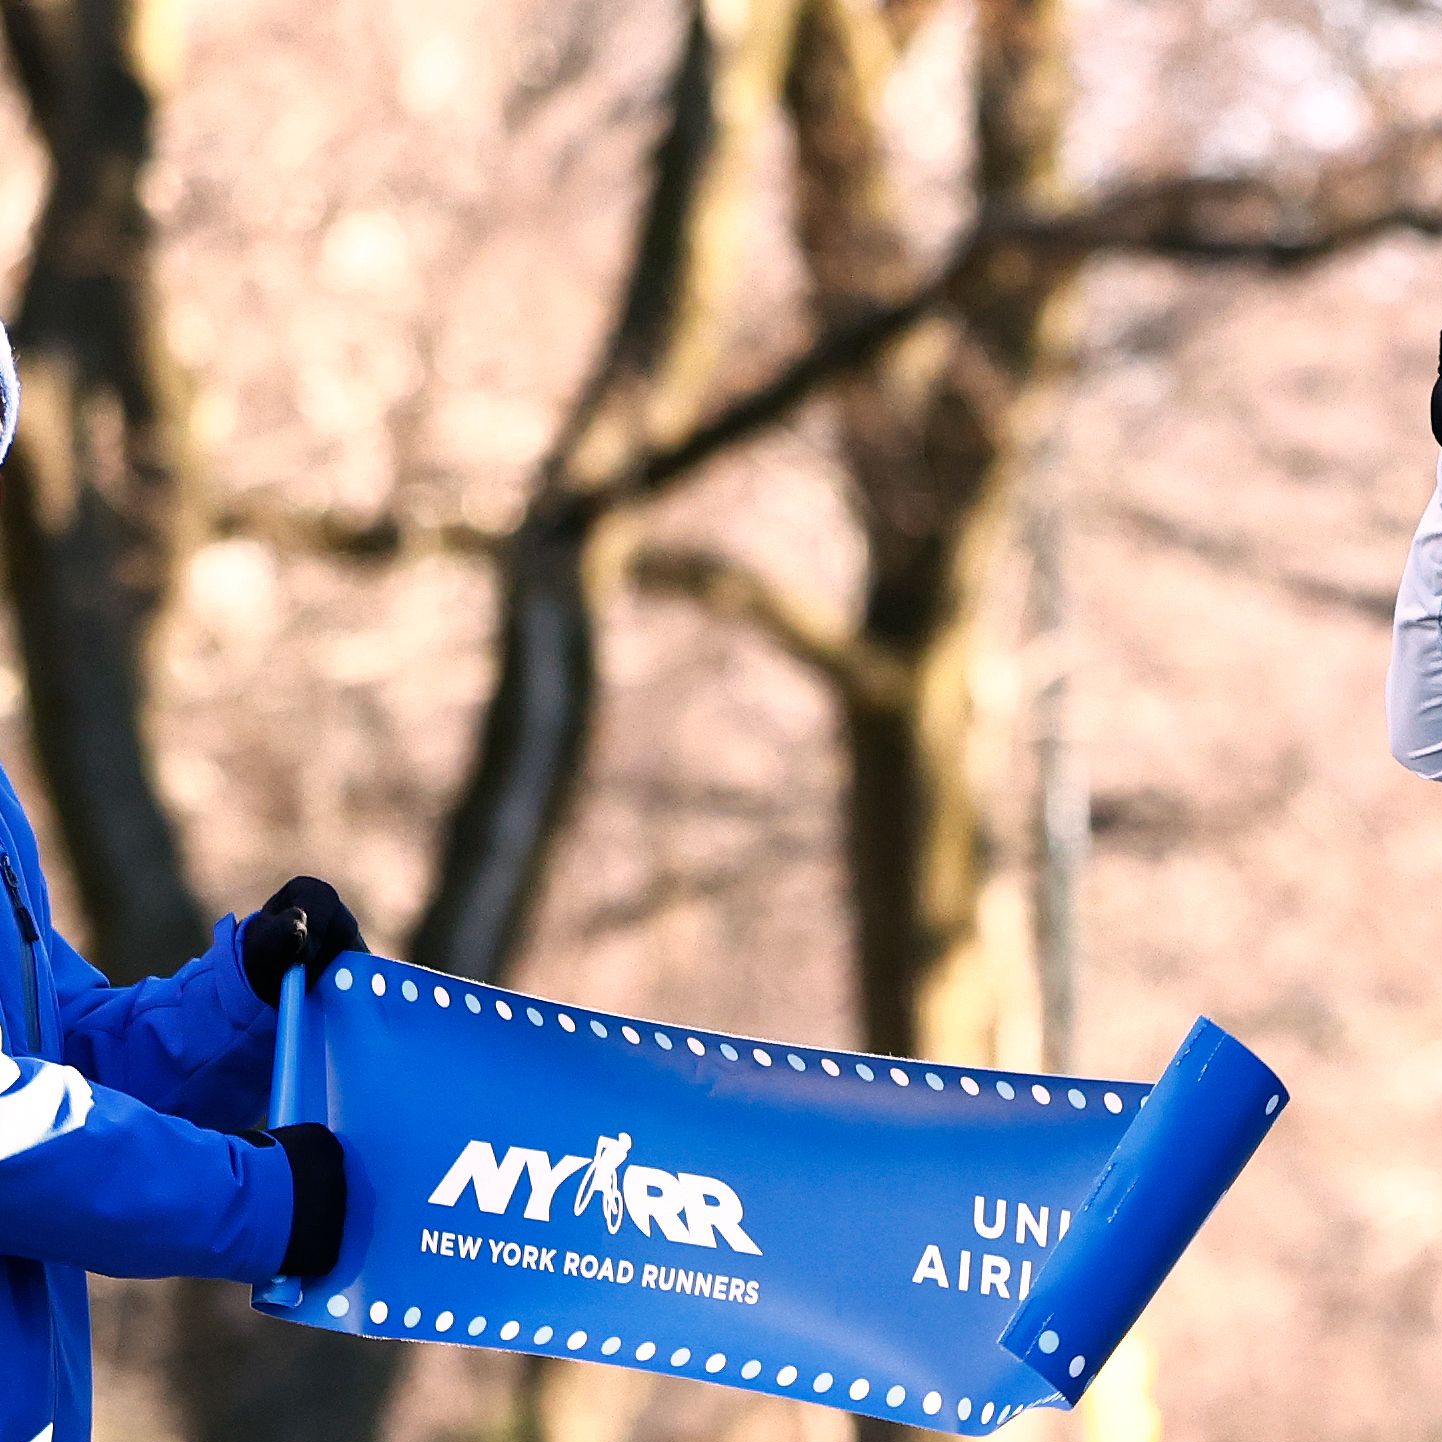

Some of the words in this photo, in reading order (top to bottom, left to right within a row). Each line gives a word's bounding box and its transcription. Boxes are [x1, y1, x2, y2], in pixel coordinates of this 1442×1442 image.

[420, 1228, 483, 1261] NEW
[488, 1238, 557, 1273] YORK
[563, 1251, 635, 1285] ROAD
[641, 1263, 761, 1306] RUNNERS
